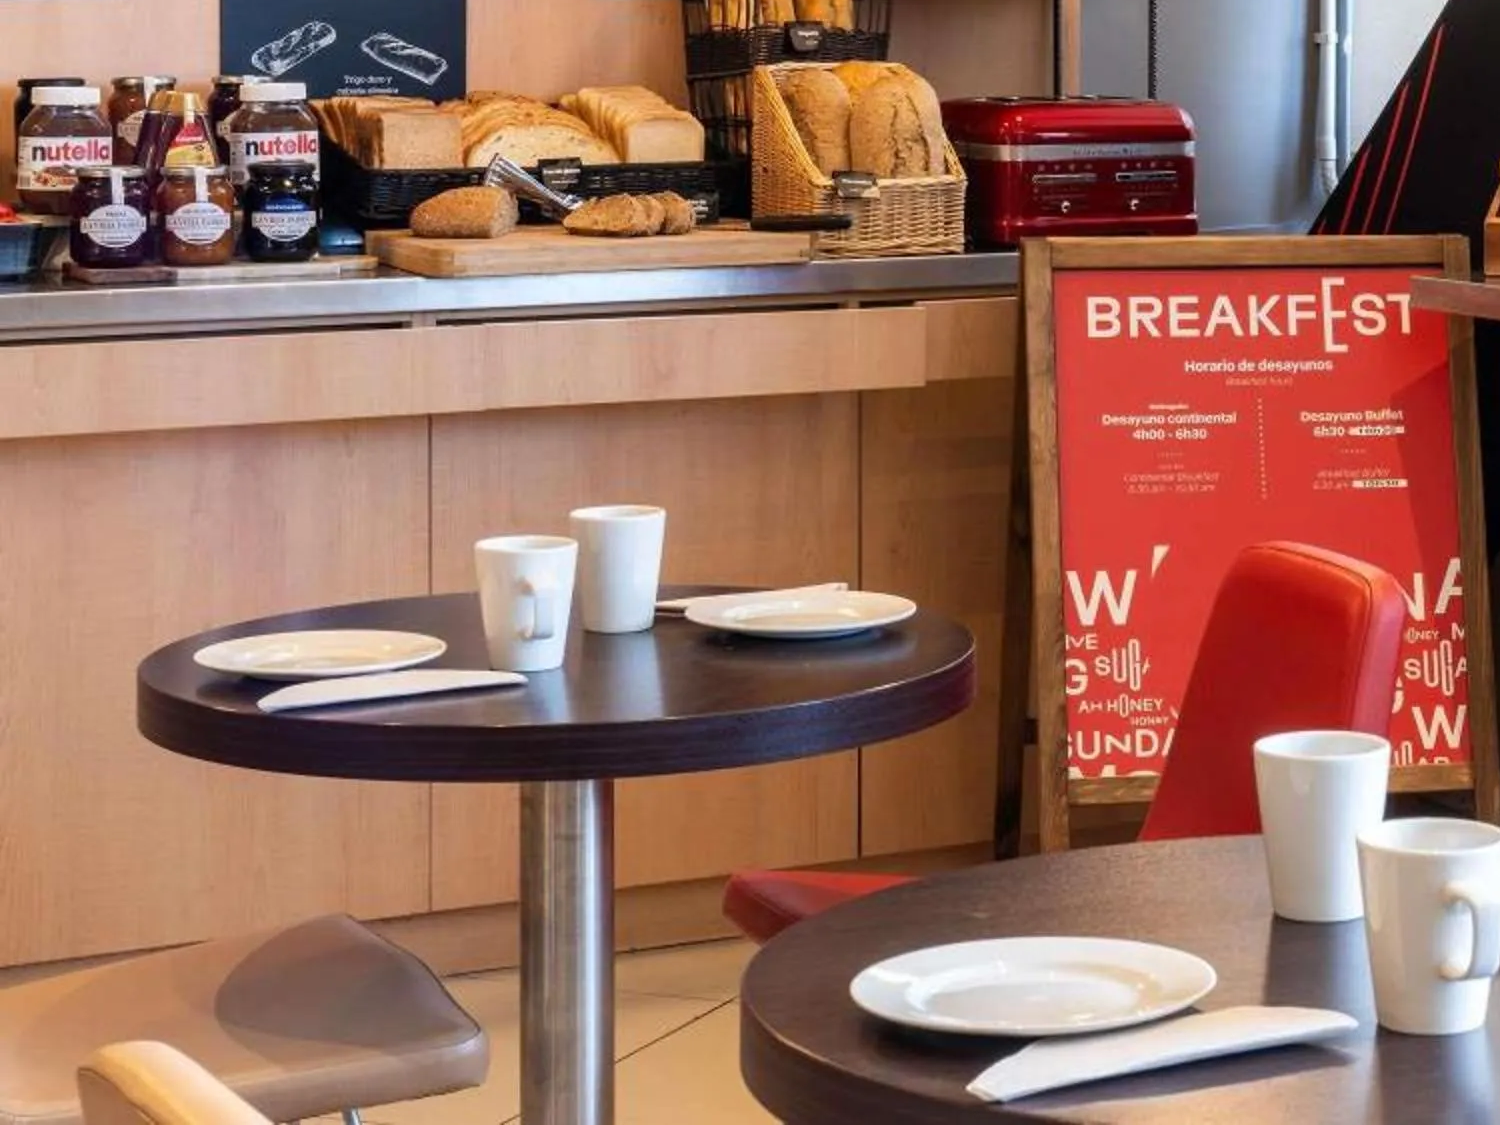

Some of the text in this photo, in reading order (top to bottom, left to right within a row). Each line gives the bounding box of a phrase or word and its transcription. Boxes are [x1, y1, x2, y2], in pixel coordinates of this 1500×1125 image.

[32, 138, 110, 162] nutella
[245, 134, 317, 156] nutella
[1086, 277, 1413, 353] BREAKFEST
[1184, 358, 1333, 374] Horario de desayunos
[1102, 412, 1237, 427] Desayuno continental
[1300, 410, 1363, 424] Desayuno
[1133, 428, 1165, 440] 4h00
[1175, 428, 1207, 440] 6h30
[1107, 693, 1164, 718] HONEY
